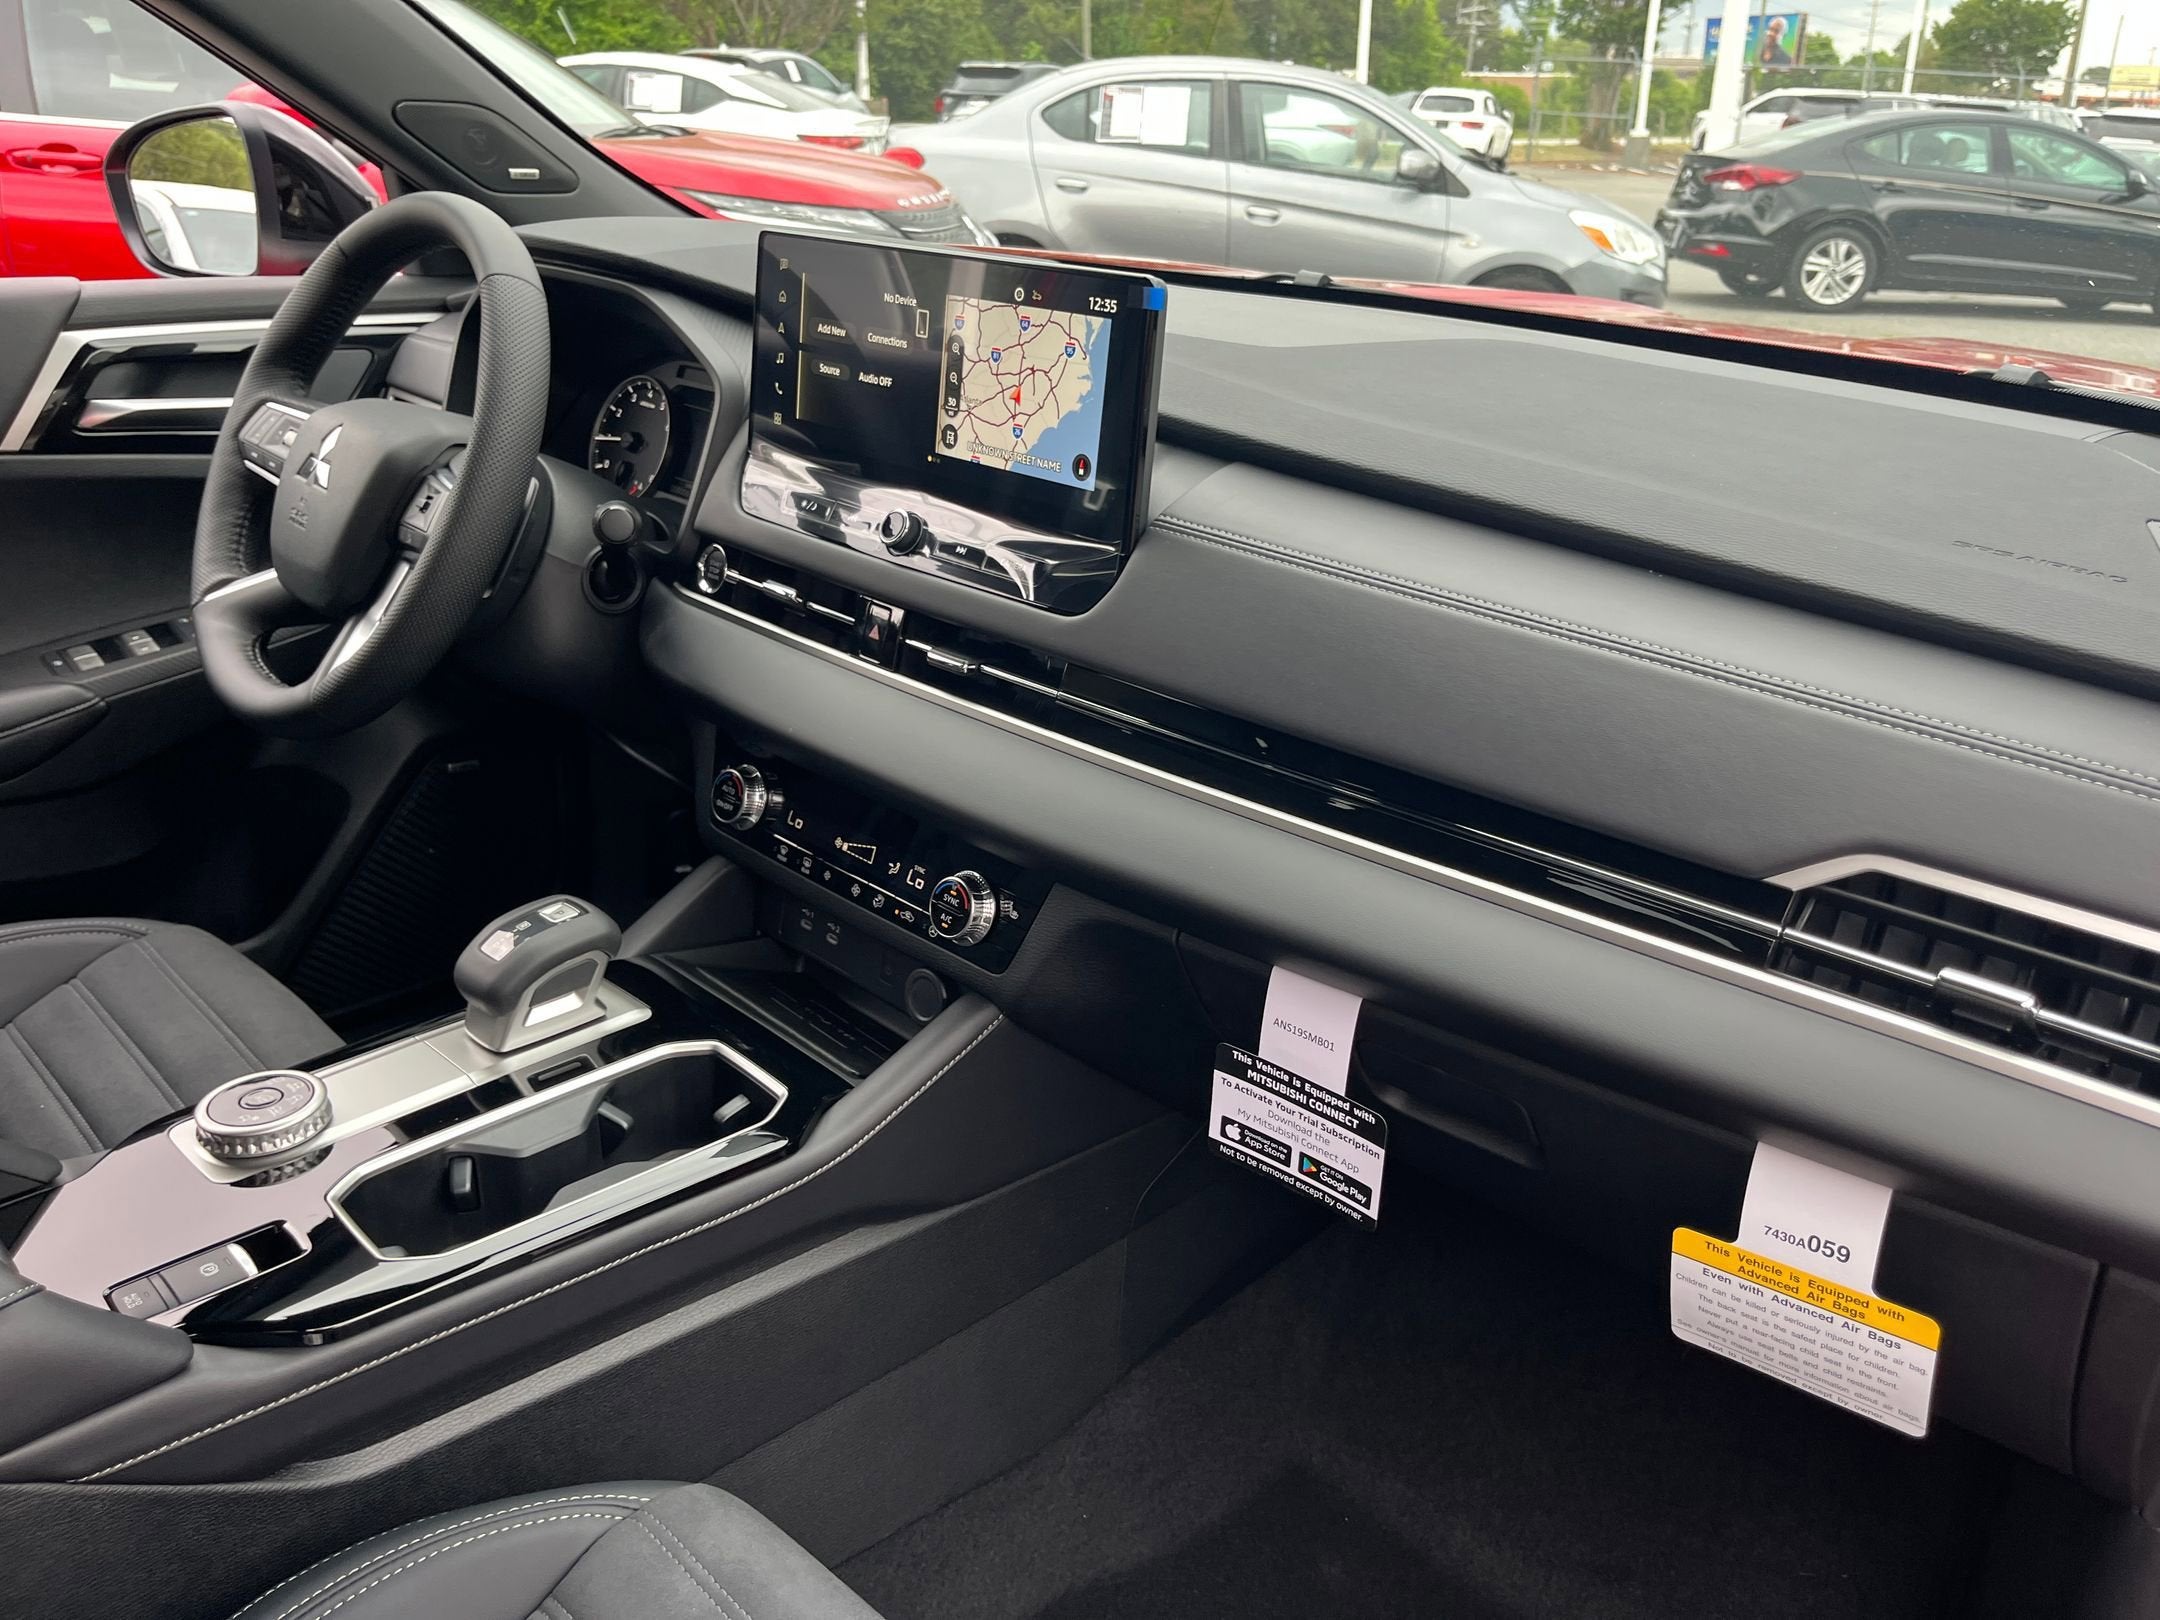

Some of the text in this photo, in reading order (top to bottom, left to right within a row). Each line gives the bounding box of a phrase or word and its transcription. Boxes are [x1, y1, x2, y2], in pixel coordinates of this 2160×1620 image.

[884, 292, 917, 306] No Device
[1088, 296, 1118, 313] 12:35
[818, 324, 846, 337] Add New
[868, 332, 908, 348] Connections
[819, 364, 840, 376] Source
[858, 372, 892, 388] Audio OFF
[948, 396, 956, 406] 30
[967, 441, 1061, 473] UNKNOWN STREET NAME
[940, 913, 952, 924] A/C
[943, 894, 960, 907] SYNC
[1273, 1018, 1335, 1052] ANS19SMB01
[1232, 1050, 1252, 1066] This
[1256, 1060, 1289, 1082] Vehicle
[1304, 1083, 1350, 1111] Equipped
[1354, 1108, 1376, 1125] with
[1247, 1069, 1359, 1129] MITSUBISHI CONNECT
[1221, 1077, 1380, 1160] To Activate Your Trial Subscription
[1268, 1110, 1330, 1146] Download the
[1238, 1108, 1360, 1174] My Mitsubishi Connect App
[1244, 1129, 1270, 1145] Download
[1279, 1145, 1288, 1154] the
[1245, 1136, 1286, 1160] App Store
[1220, 1144, 1363, 1222] Not to be removed except by owner.
[1319, 1171, 1367, 1204] Google Play
[1320, 1165, 1330, 1174] GET
[1335, 1172, 1344, 1181] ON
[1764, 1225, 1851, 1264] 7430A059
[1705, 1241, 1905, 1322] This Vehicle is Equipped with
[1738, 1265, 1866, 1320] Advanced Air Bags
[1675, 1272, 1928, 1377] Children can be killed or seriously injured by the air bag.
[1702, 1267, 1902, 1350] Even with Advanced Air Bags
[1698, 1294, 1899, 1378] The back seat is the safest place for children.
[1698, 1305, 1721, 1319] Never
[1725, 1317, 1738, 1326] put
[1752, 1327, 1796, 1350] rear-facing
[1800, 1346, 1819, 1358] child
[1823, 1356, 1842, 1367] seat
[1846, 1364, 1854, 1373] in
[1858, 1369, 1872, 1380] the
[1877, 1377, 1899, 1391] front.
[1677, 1318, 1921, 1422] See owner's manual for more information about air bags.
[1707, 1320, 1887, 1398] Always use seat belts and child restraints.
[1708, 1341, 1724, 1353] Not
[1741, 1356, 1753, 1365] be
[1758, 1363, 1797, 1384] removed
[1801, 1382, 1833, 1400] except
[1837, 1396, 1849, 1406] by
[1854, 1404, 1884, 1419] owner.
